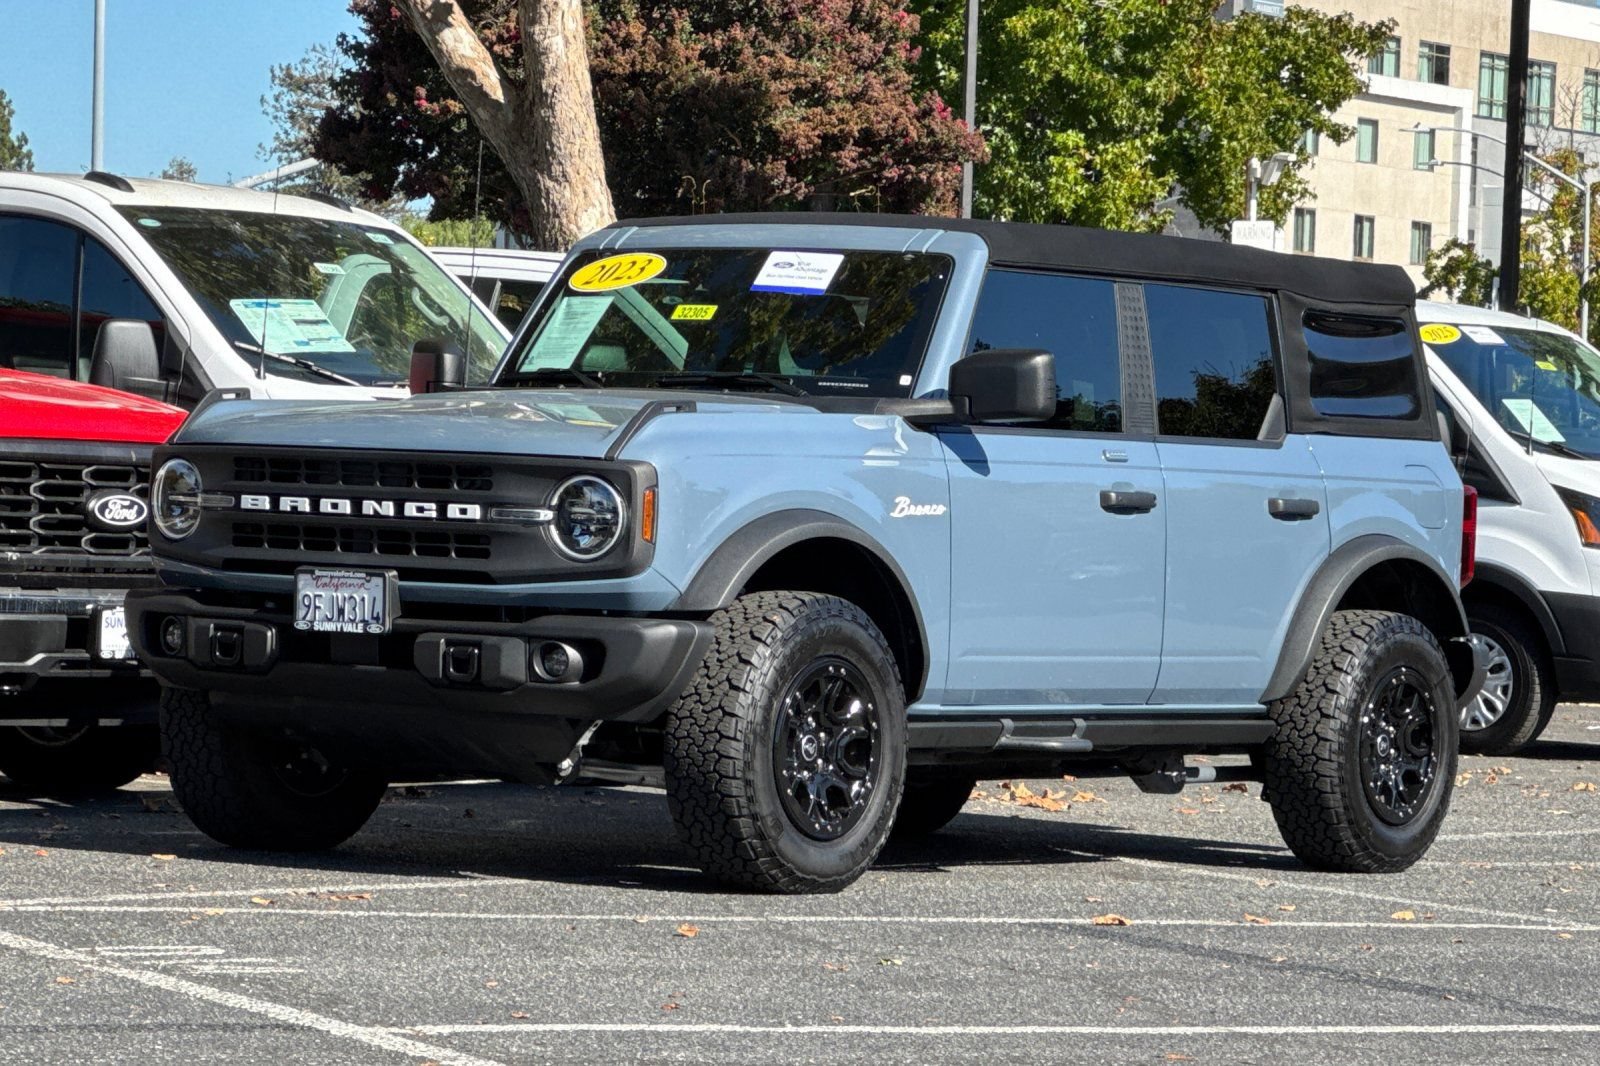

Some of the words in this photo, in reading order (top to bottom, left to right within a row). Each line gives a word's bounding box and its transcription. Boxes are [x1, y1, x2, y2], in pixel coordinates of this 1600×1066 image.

[580, 258, 654, 286] 2023
[677, 306, 711, 319] 32305
[1424, 326, 1455, 342] 2025
[104, 498, 138, 521] Ford
[240, 494, 481, 520] BRONCO
[889, 496, 947, 518] Bronco
[314, 576, 371, 592] California
[301, 593, 381, 624] 9FJW314
[313, 621, 364, 633] SUNNYVALE
